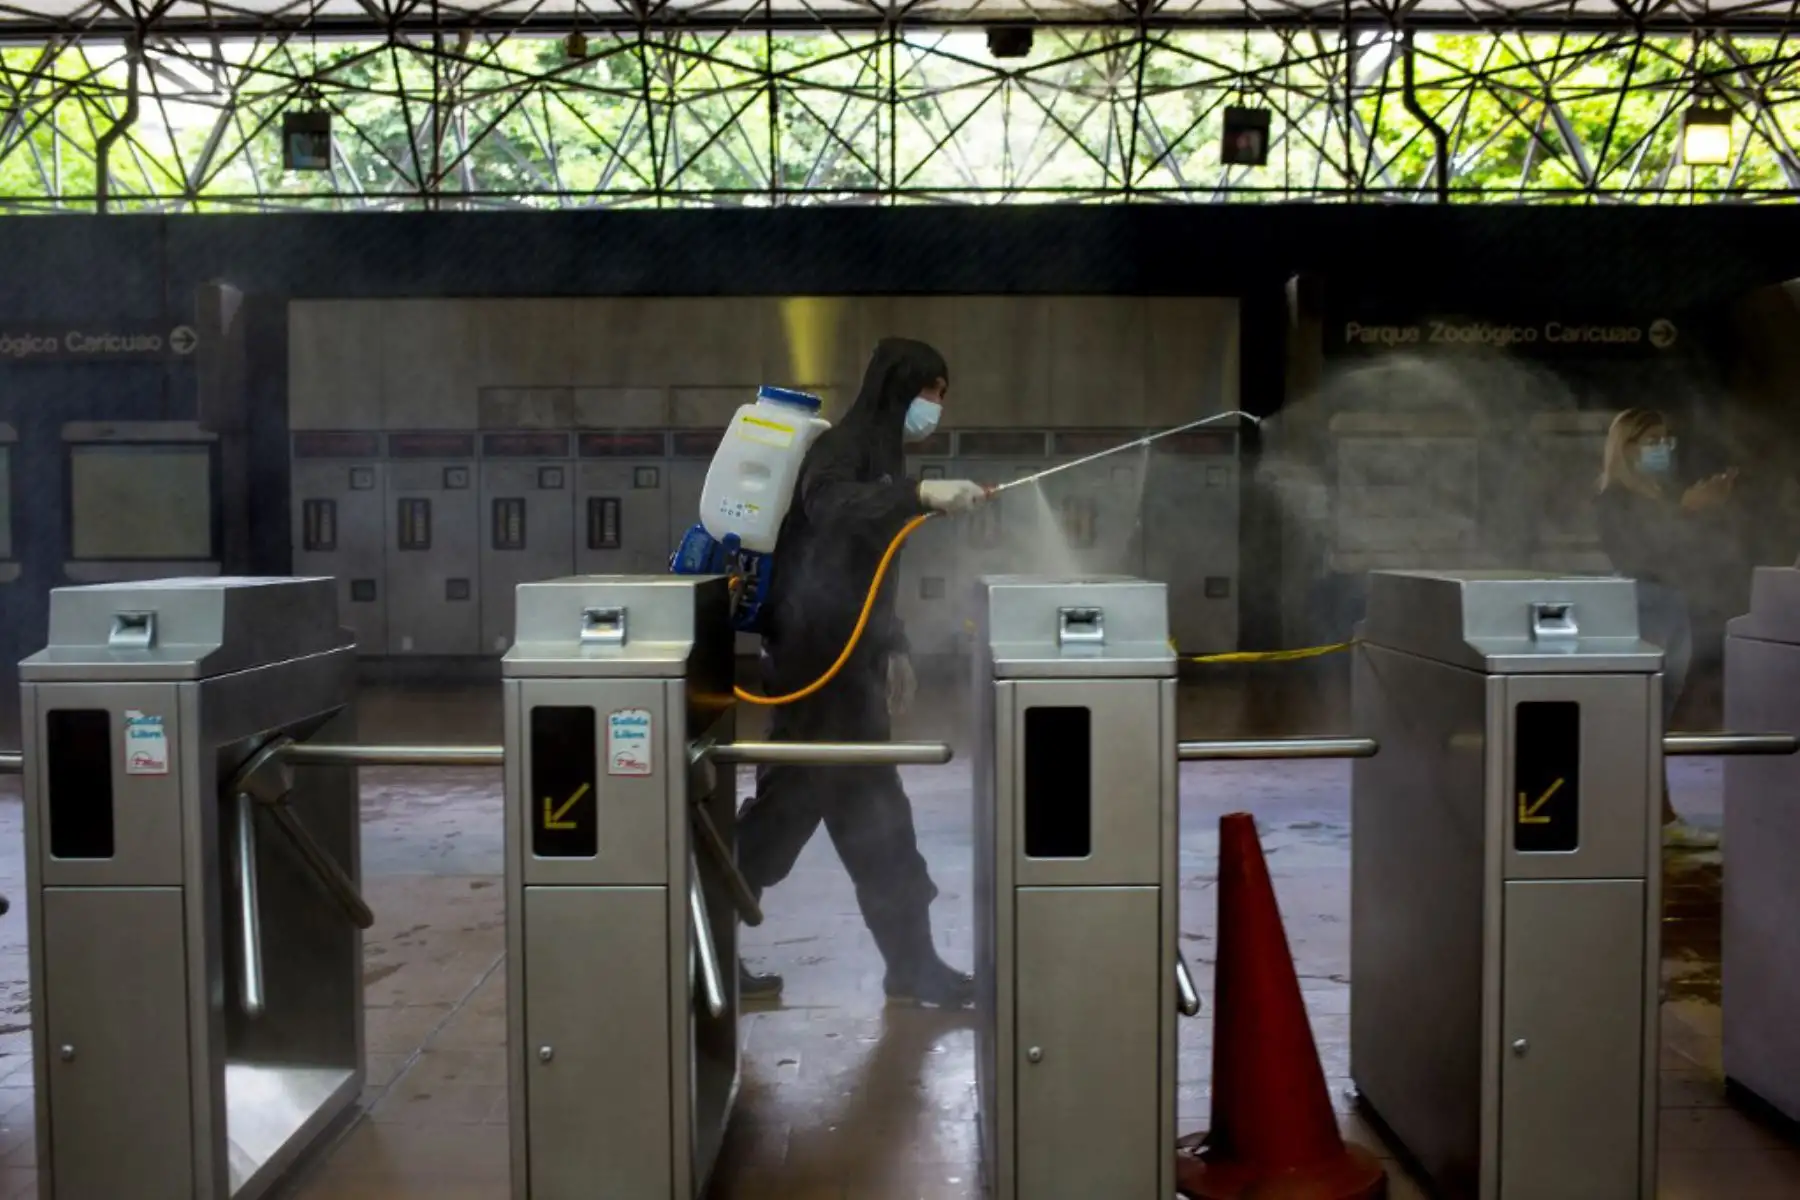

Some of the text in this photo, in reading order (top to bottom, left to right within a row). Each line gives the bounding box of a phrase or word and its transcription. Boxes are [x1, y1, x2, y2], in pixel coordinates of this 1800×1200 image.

[1346, 320, 1642, 346] Parque Zoológico Caricuao
